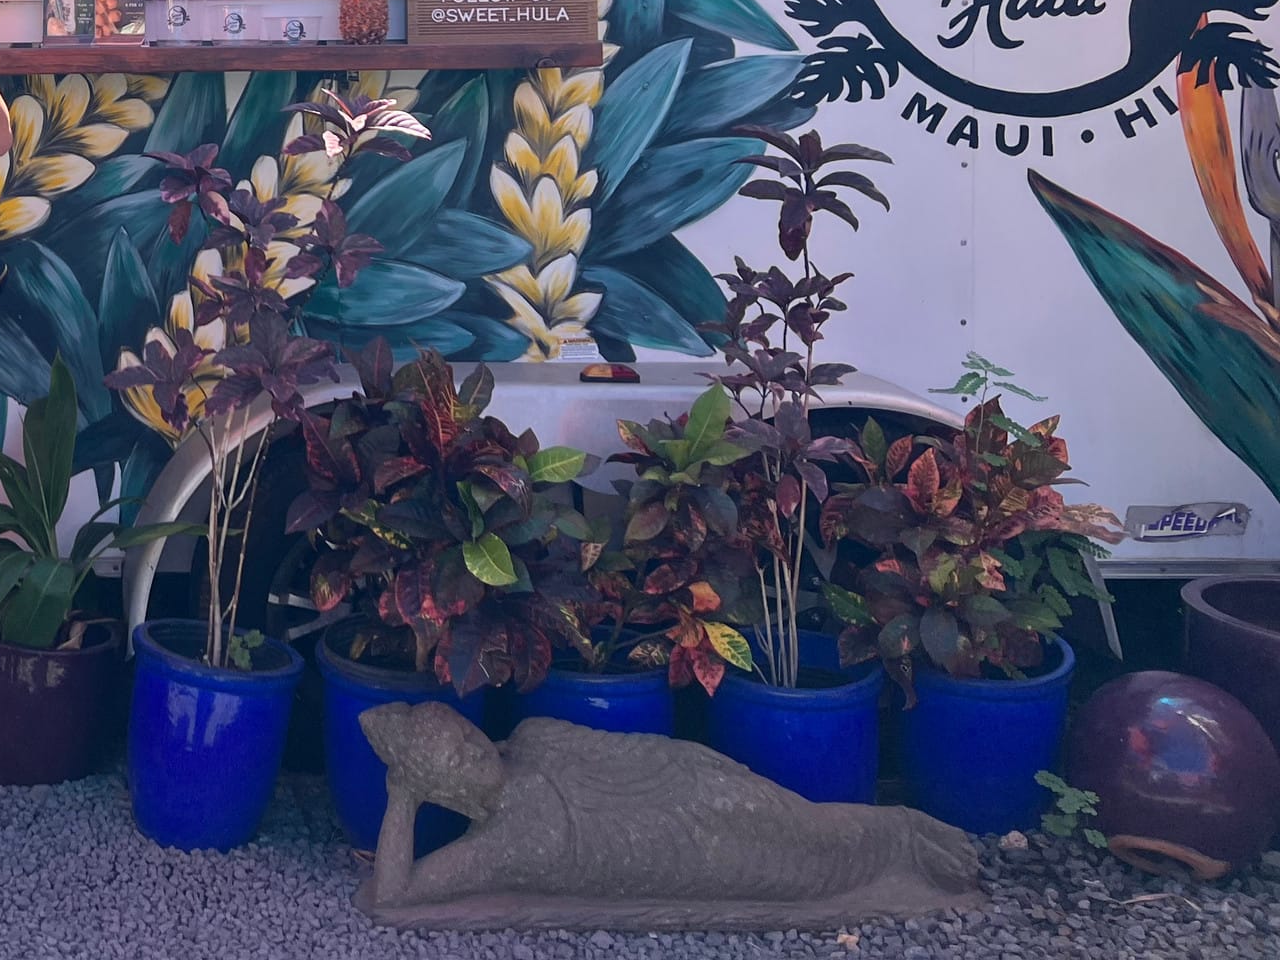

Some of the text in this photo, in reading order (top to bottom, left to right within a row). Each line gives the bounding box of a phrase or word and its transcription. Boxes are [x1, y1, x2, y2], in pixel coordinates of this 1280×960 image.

[431, 7, 569, 23] @SWEET_HULA
[901, 85, 1179, 157] MAUI HI
